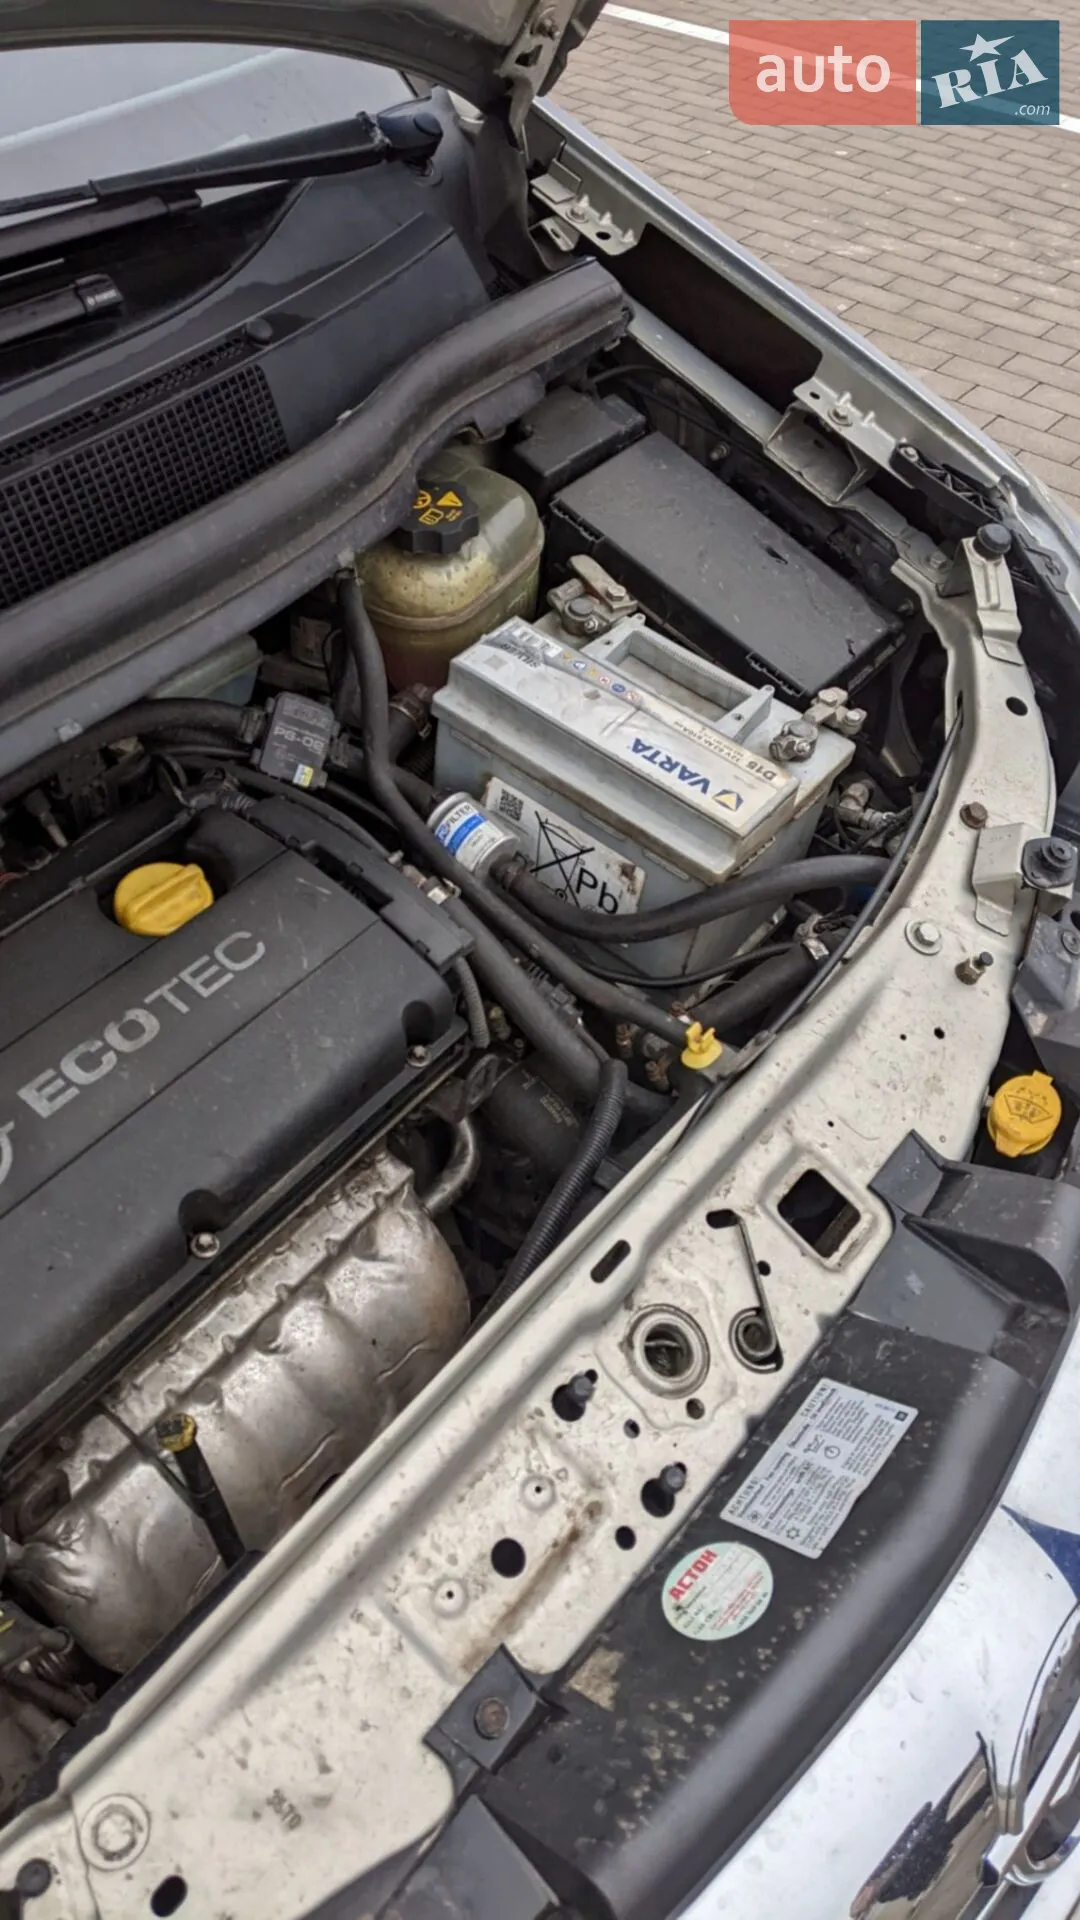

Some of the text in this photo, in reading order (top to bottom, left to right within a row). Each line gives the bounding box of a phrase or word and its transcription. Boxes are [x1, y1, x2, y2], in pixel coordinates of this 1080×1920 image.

[631, 738, 711, 795] VARTA
[746, 760, 777, 780] D15
[576, 865, 618, 913] Pb
[17, 930, 266, 1118] ECOTEC
